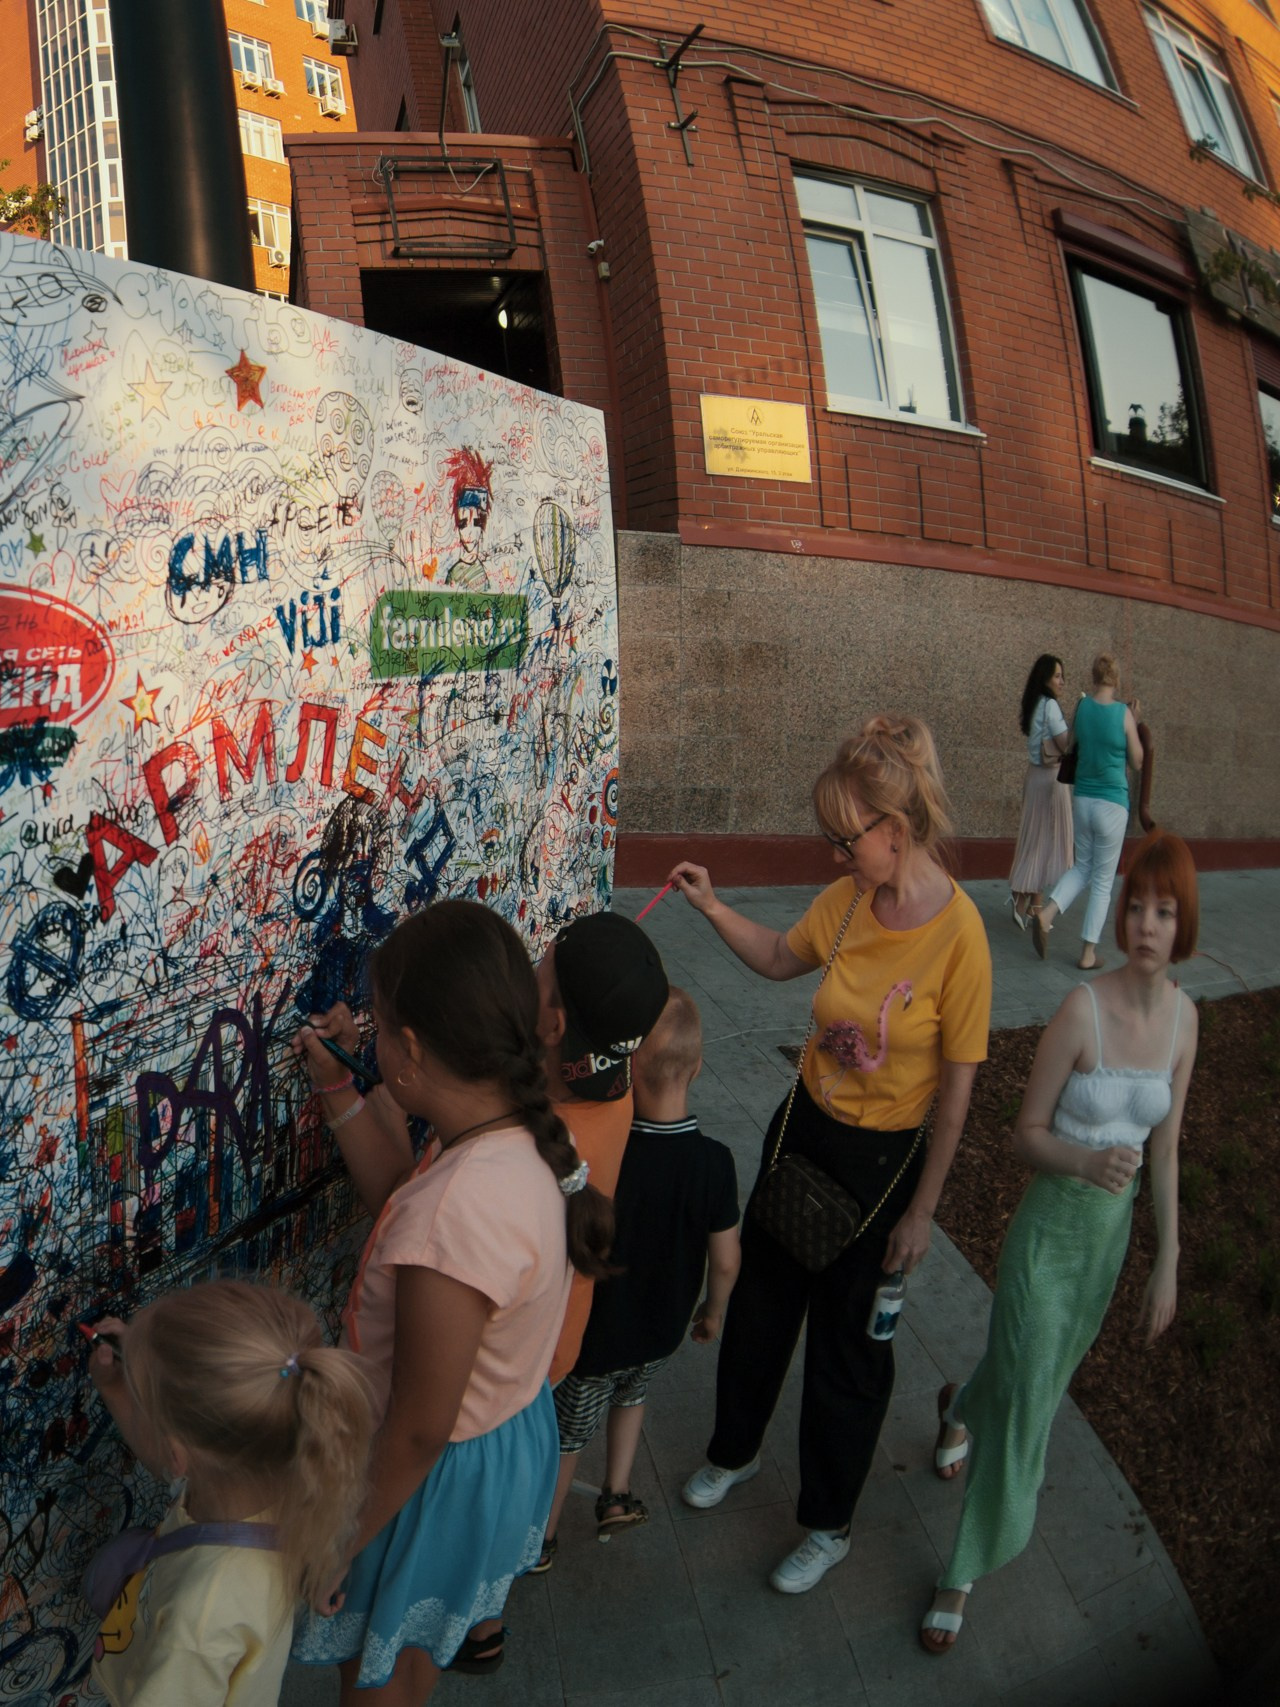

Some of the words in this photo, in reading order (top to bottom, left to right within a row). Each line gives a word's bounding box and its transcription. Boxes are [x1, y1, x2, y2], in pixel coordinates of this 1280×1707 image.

[730, 427, 748, 436] Союз
[708, 435, 767, 447] саморегулируемая
[767, 440, 805, 450] организация
[713, 442, 756, 453] арбитражных
[25, 645, 83, 663] СЕТЬ
